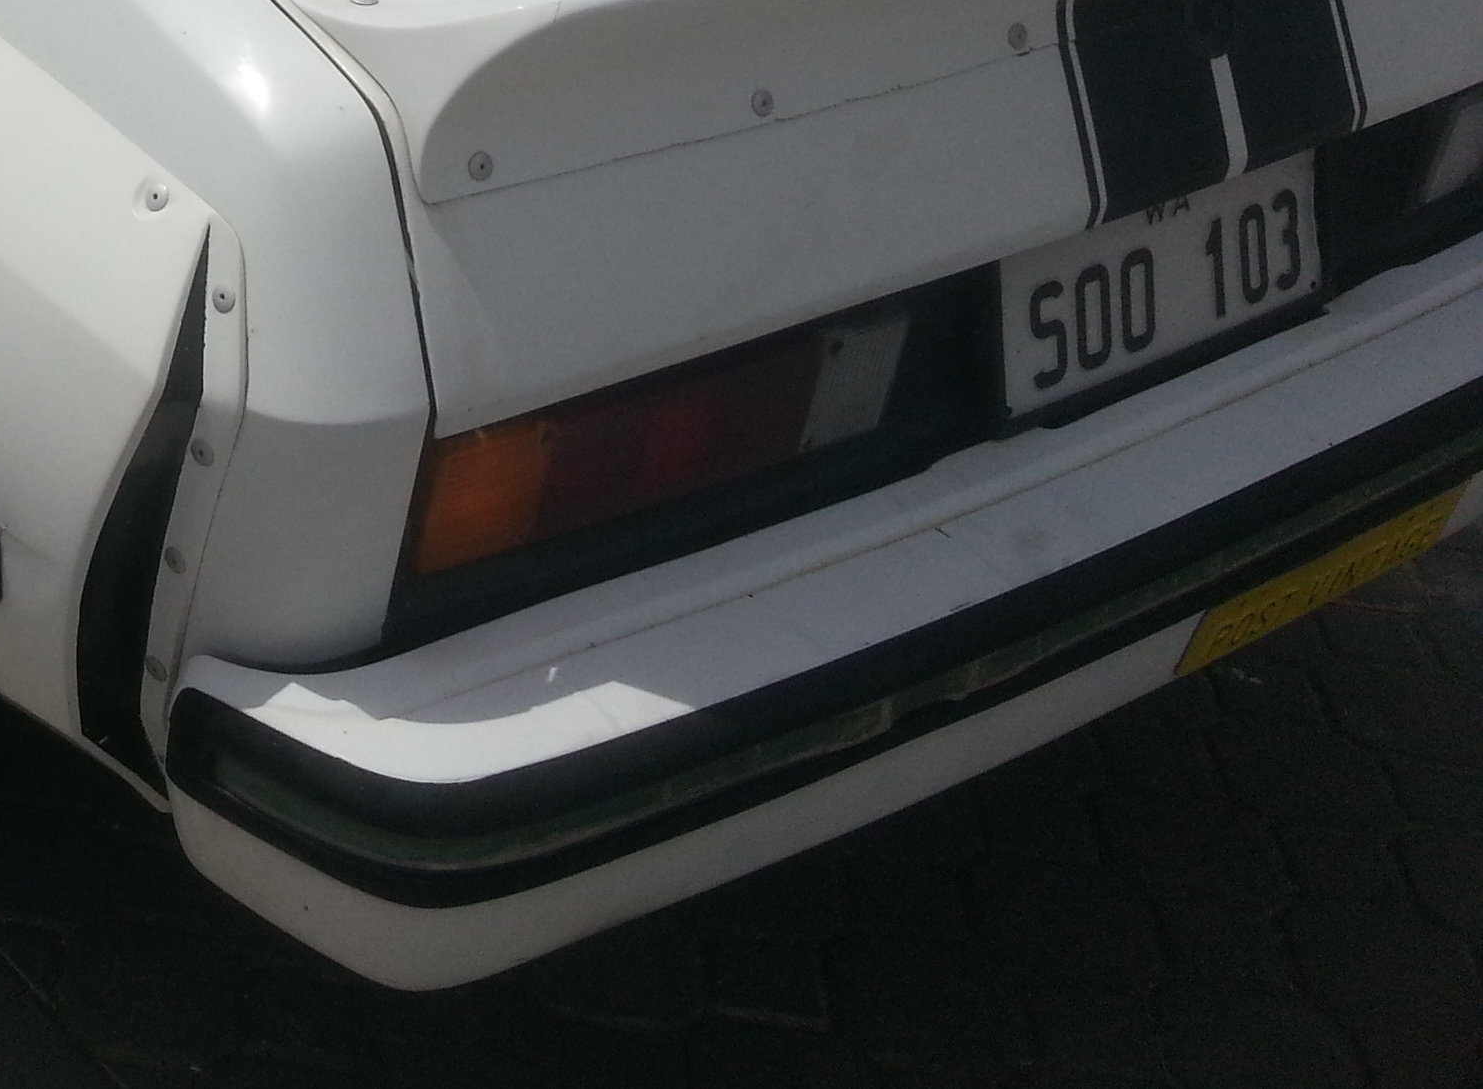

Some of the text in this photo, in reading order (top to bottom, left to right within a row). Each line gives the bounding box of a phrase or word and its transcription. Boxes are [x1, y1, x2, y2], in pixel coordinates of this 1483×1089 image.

[1145, 195, 1191, 225] WA
[1205, 188, 1302, 319] 103
[1204, 514, 1443, 658] POST VINTAGE
